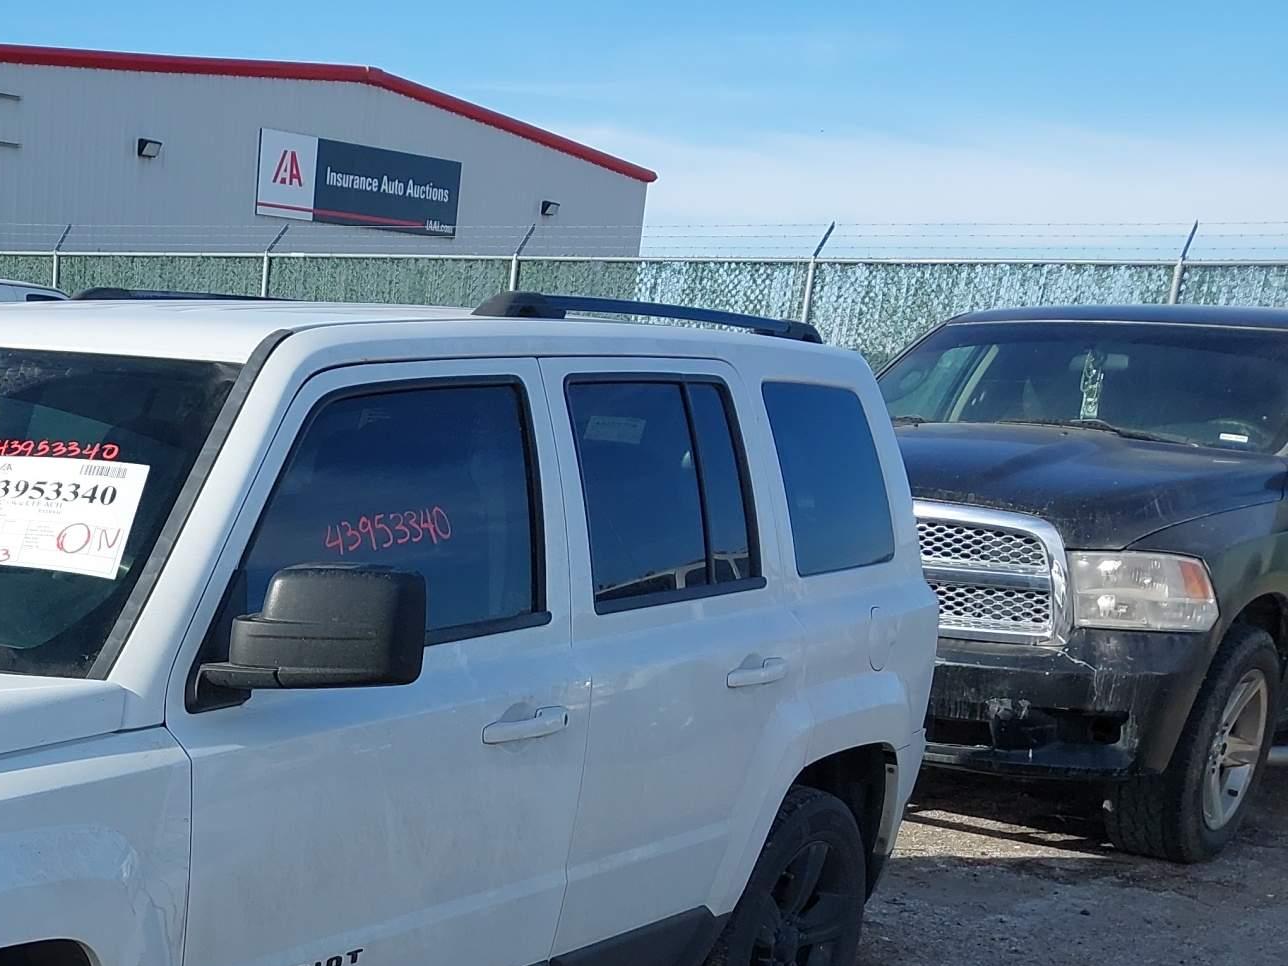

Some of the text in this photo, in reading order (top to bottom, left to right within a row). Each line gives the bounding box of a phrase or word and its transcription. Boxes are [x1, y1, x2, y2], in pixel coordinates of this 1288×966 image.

[325, 166, 450, 203] Insurance Auto Auctions
[325, 504, 452, 555] 43953340
